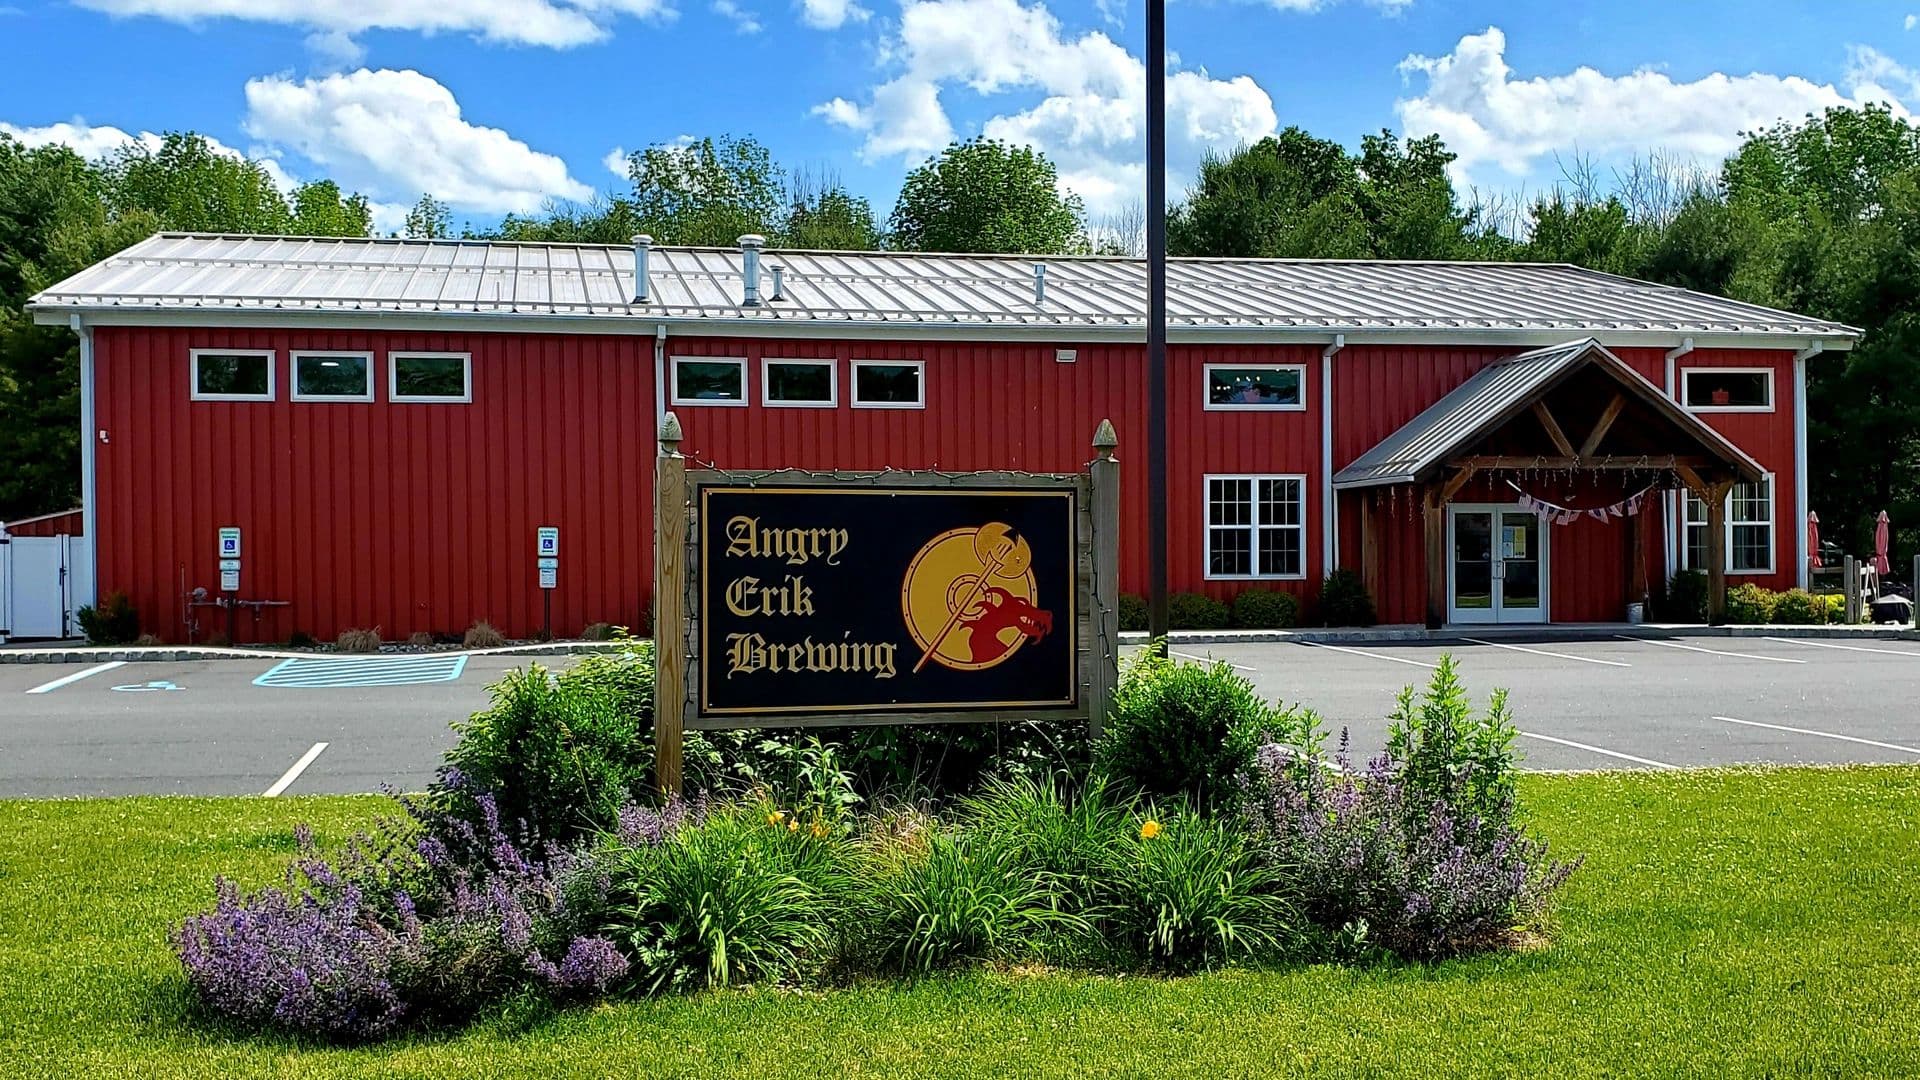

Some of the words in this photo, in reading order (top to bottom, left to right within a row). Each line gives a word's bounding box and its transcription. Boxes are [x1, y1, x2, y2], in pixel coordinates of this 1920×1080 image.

[726, 516, 848, 565] Angry
[726, 575, 815, 616] Erik
[726, 631, 896, 679] Brewing
